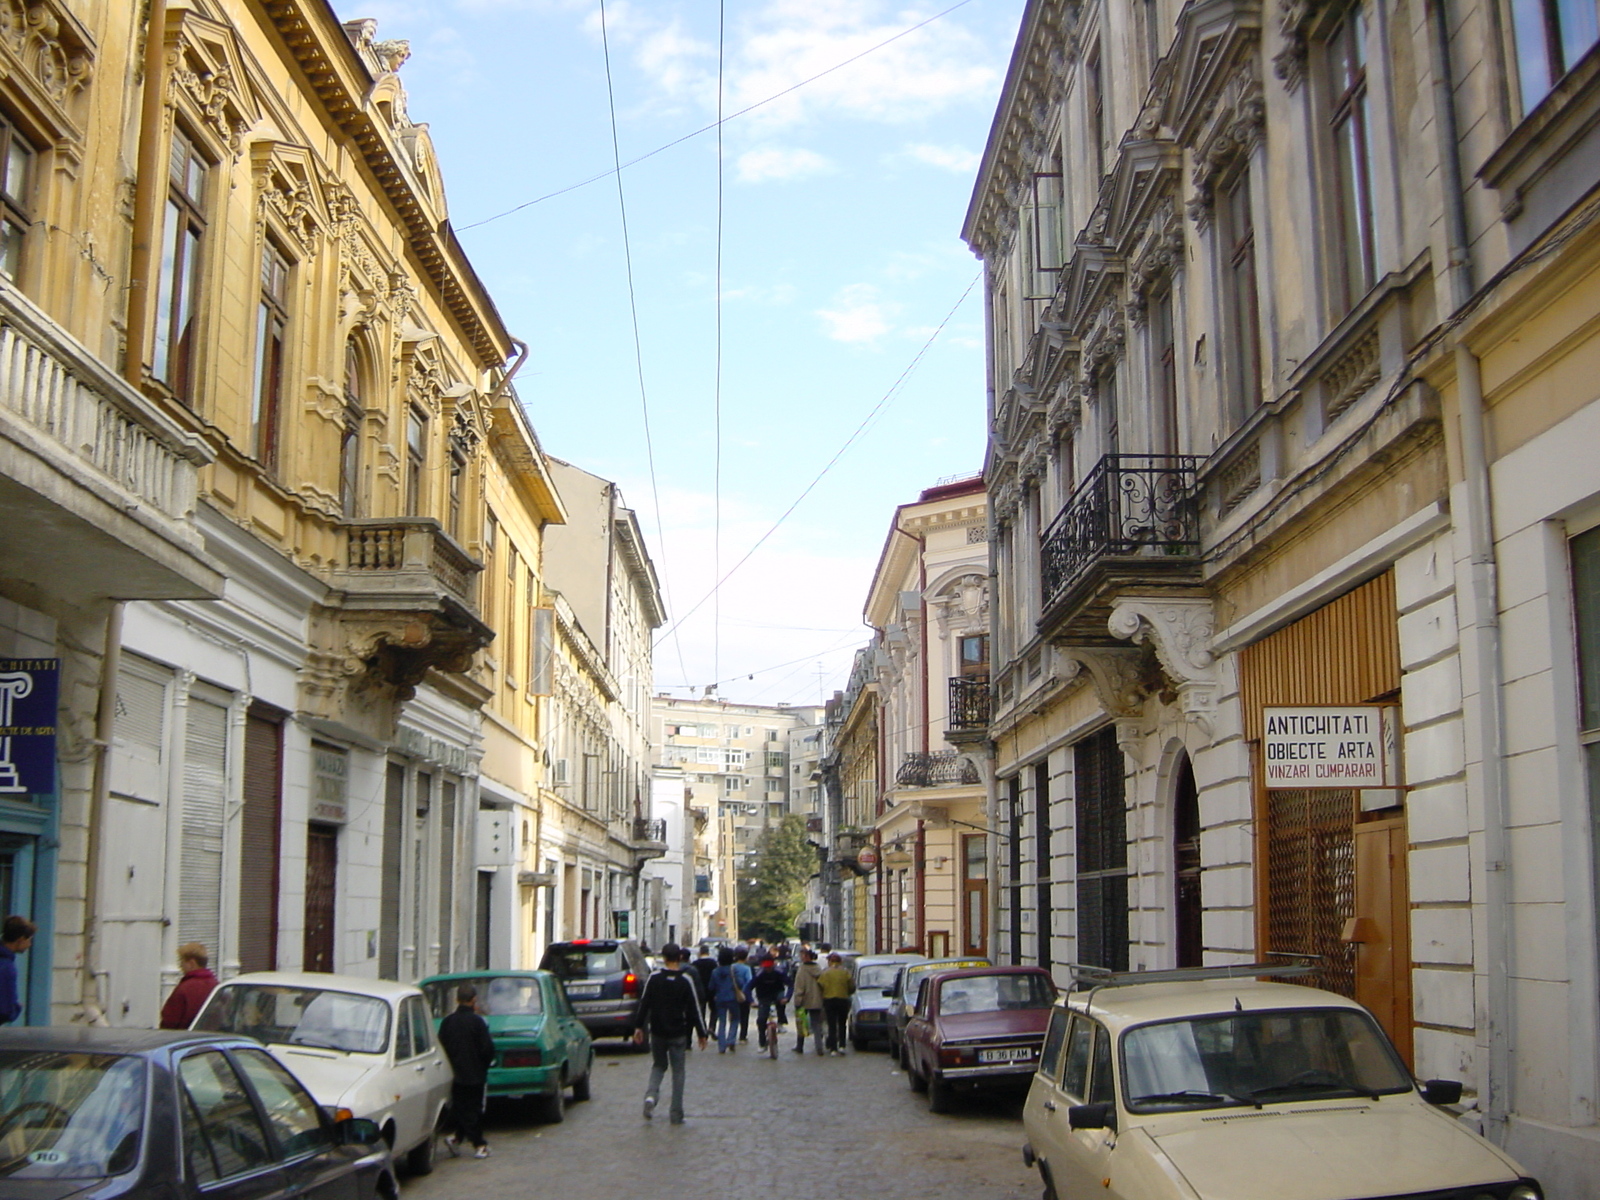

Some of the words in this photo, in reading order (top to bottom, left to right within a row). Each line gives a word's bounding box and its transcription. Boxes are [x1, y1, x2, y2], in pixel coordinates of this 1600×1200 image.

[1267, 715, 1369, 735] ANTICHITATI
[1267, 742, 1327, 760] OBIECTE
[1338, 741, 1375, 759] ARTA
[1268, 764, 1310, 780] VINZARI
[1315, 763, 1376, 778] CUMPARARI
